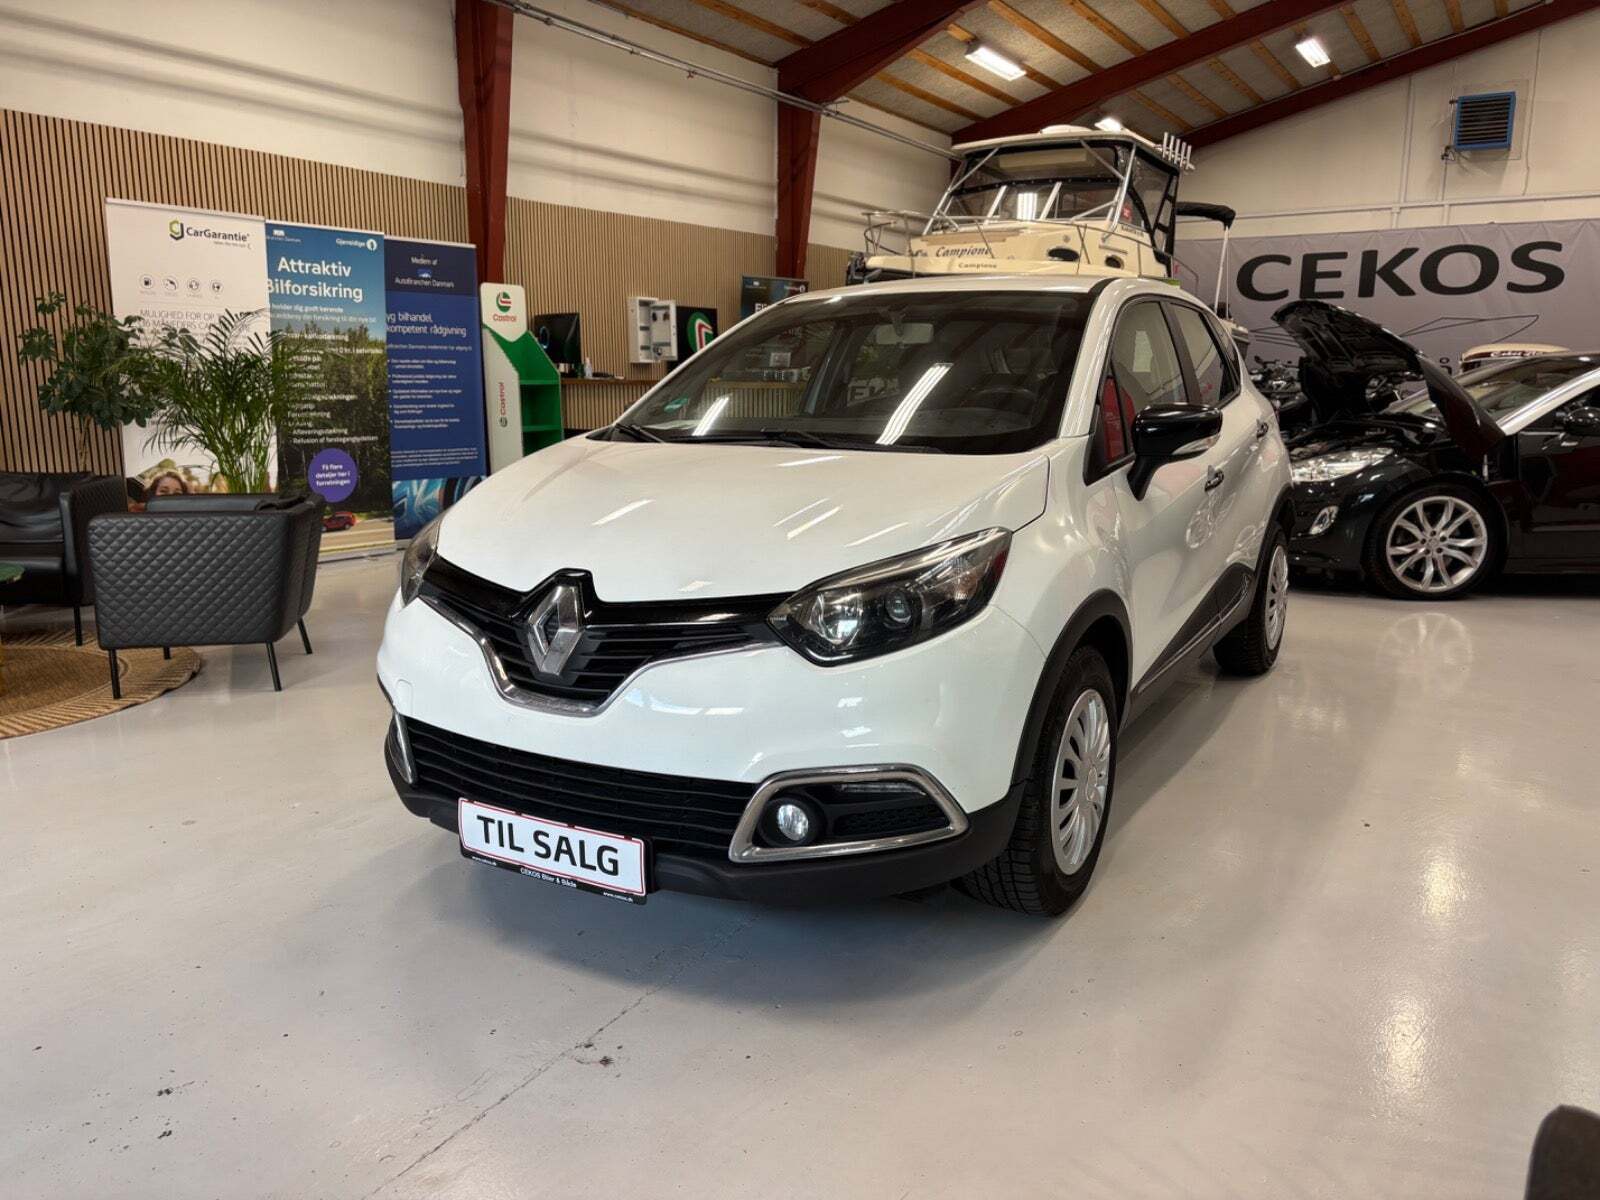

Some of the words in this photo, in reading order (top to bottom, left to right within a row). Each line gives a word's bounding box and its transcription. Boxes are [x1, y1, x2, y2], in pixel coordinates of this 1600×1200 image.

[186, 226, 248, 242] CarGarantie
[278, 256, 352, 277] Attraktiv
[1236, 241, 1565, 301] CEKOS
[267, 278, 363, 303] Bilforsikring
[493, 313, 517, 323] Castrol
[477, 815, 524, 853] TIL
[533, 830, 619, 876] SALG
